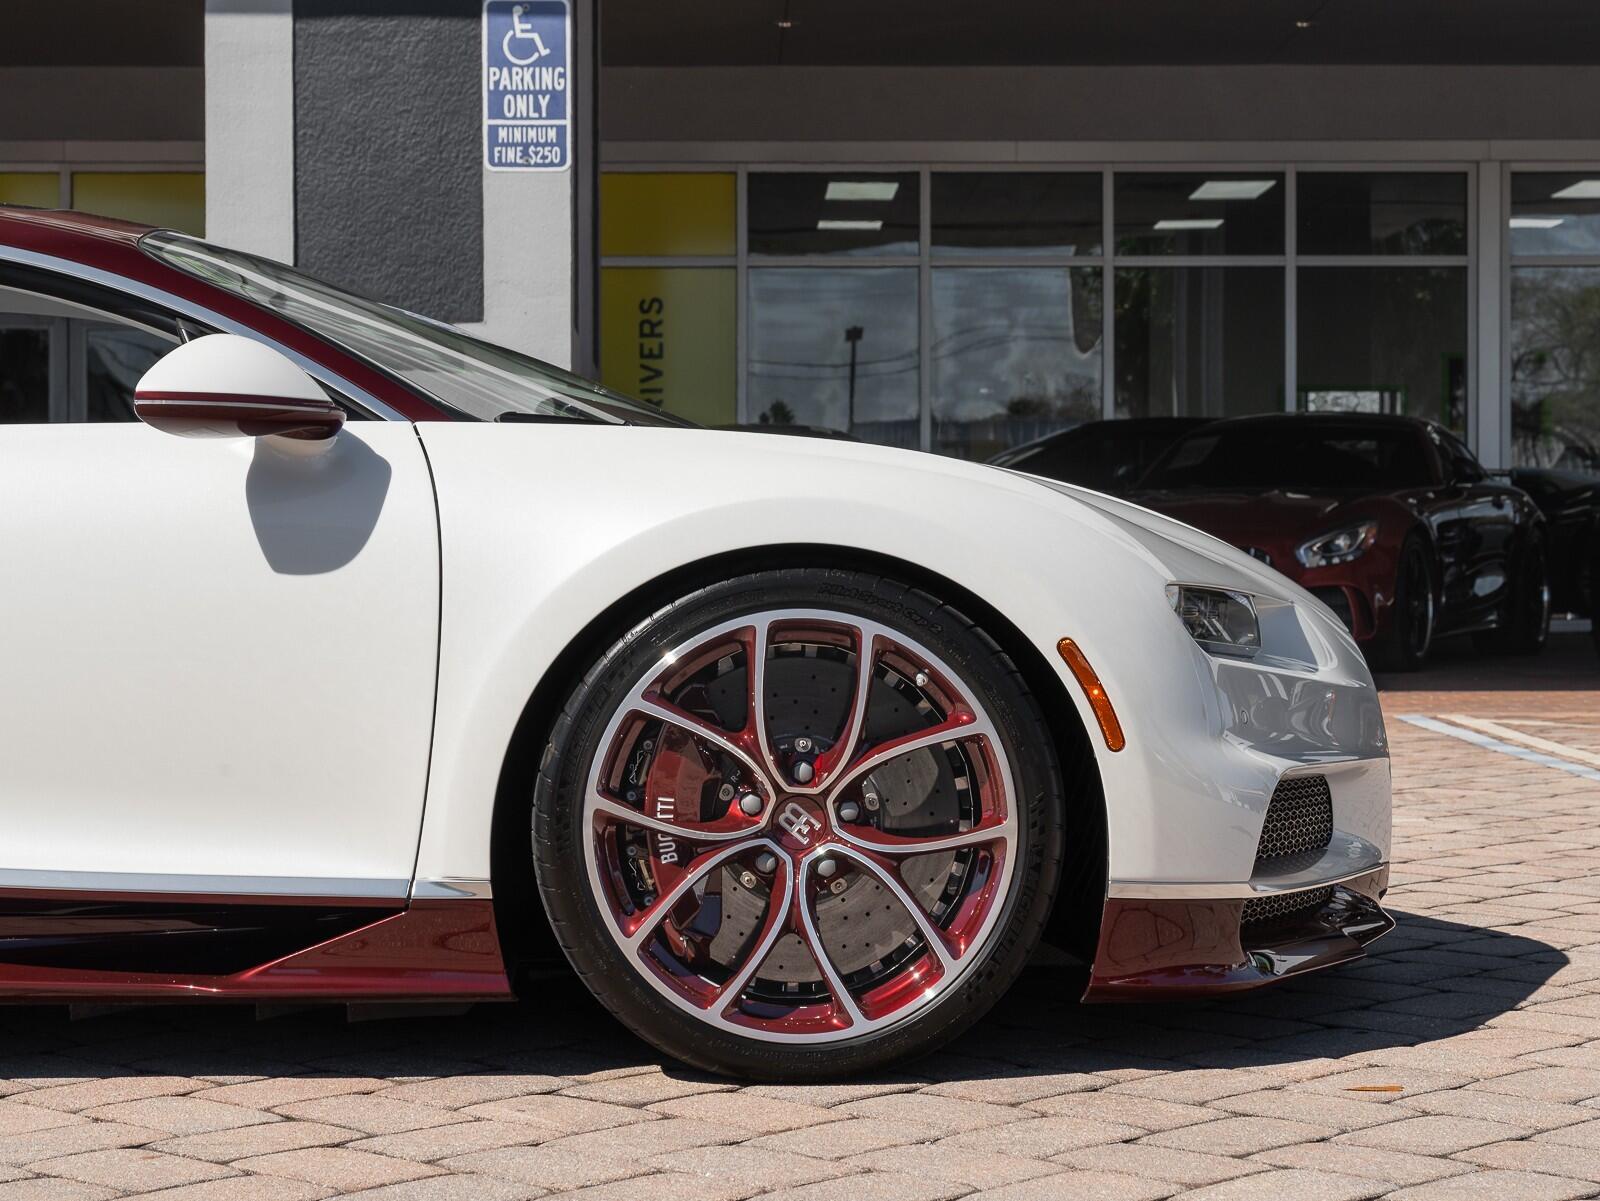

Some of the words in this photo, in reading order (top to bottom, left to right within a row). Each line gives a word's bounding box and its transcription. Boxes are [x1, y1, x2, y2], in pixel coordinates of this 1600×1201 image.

[488, 66, 565, 91] PARKING
[503, 94, 550, 118] ONLY
[498, 126, 557, 143] MINIMUM
[494, 146, 523, 164] FINE
[528, 145, 560, 165] $250
[655, 796, 678, 864] BUTTI
